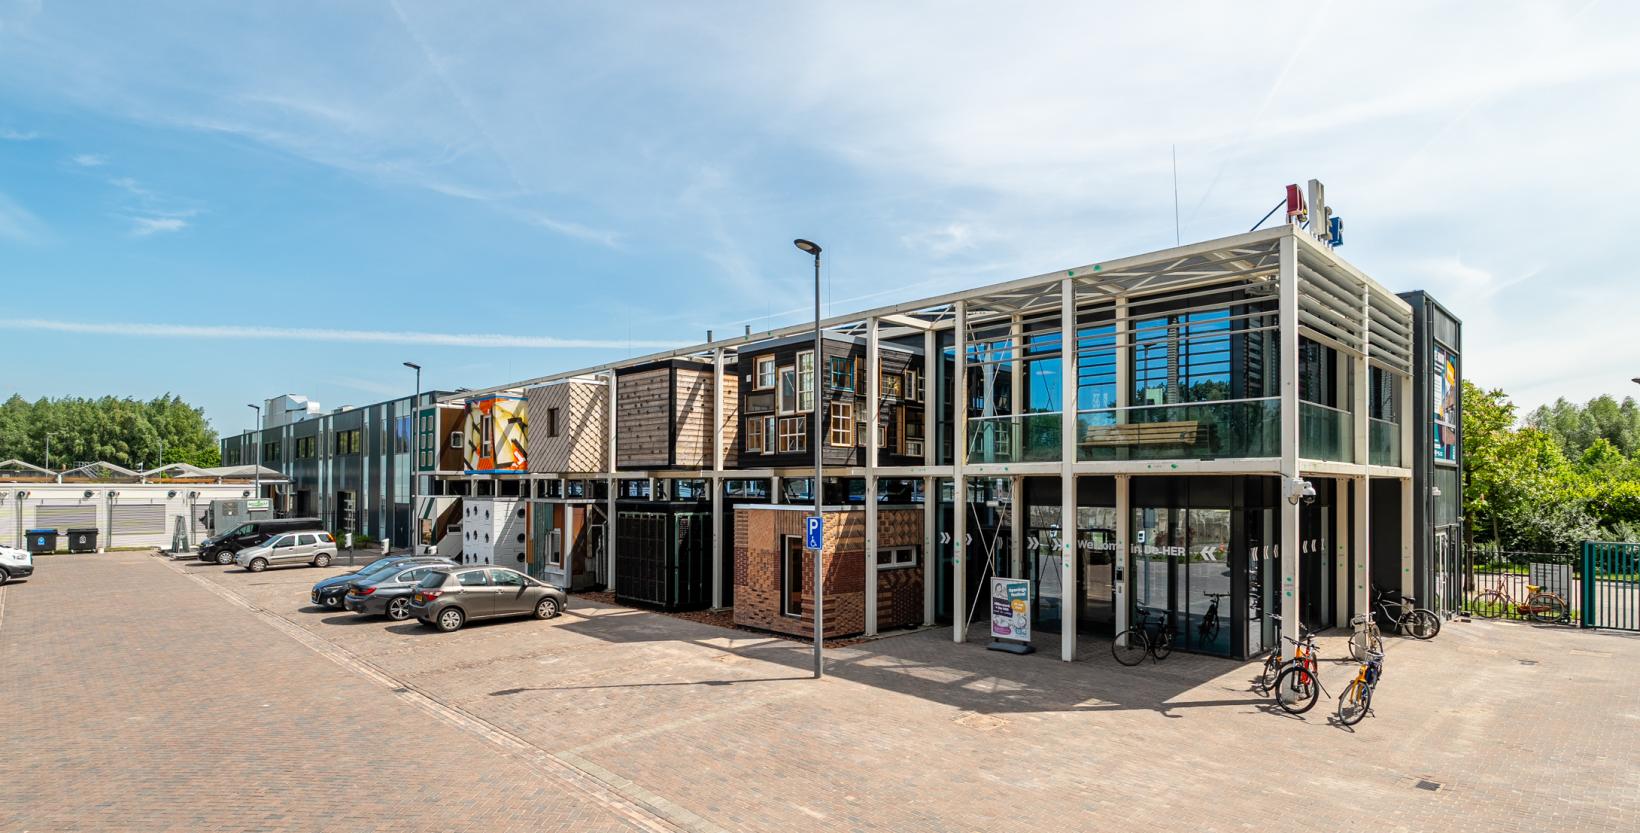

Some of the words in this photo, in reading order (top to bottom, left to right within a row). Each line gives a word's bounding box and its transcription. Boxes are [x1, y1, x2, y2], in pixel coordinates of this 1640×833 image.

[810, 519, 818, 535] P
[1130, 543, 1142, 554] in
[1162, 545, 1186, 557] HER
